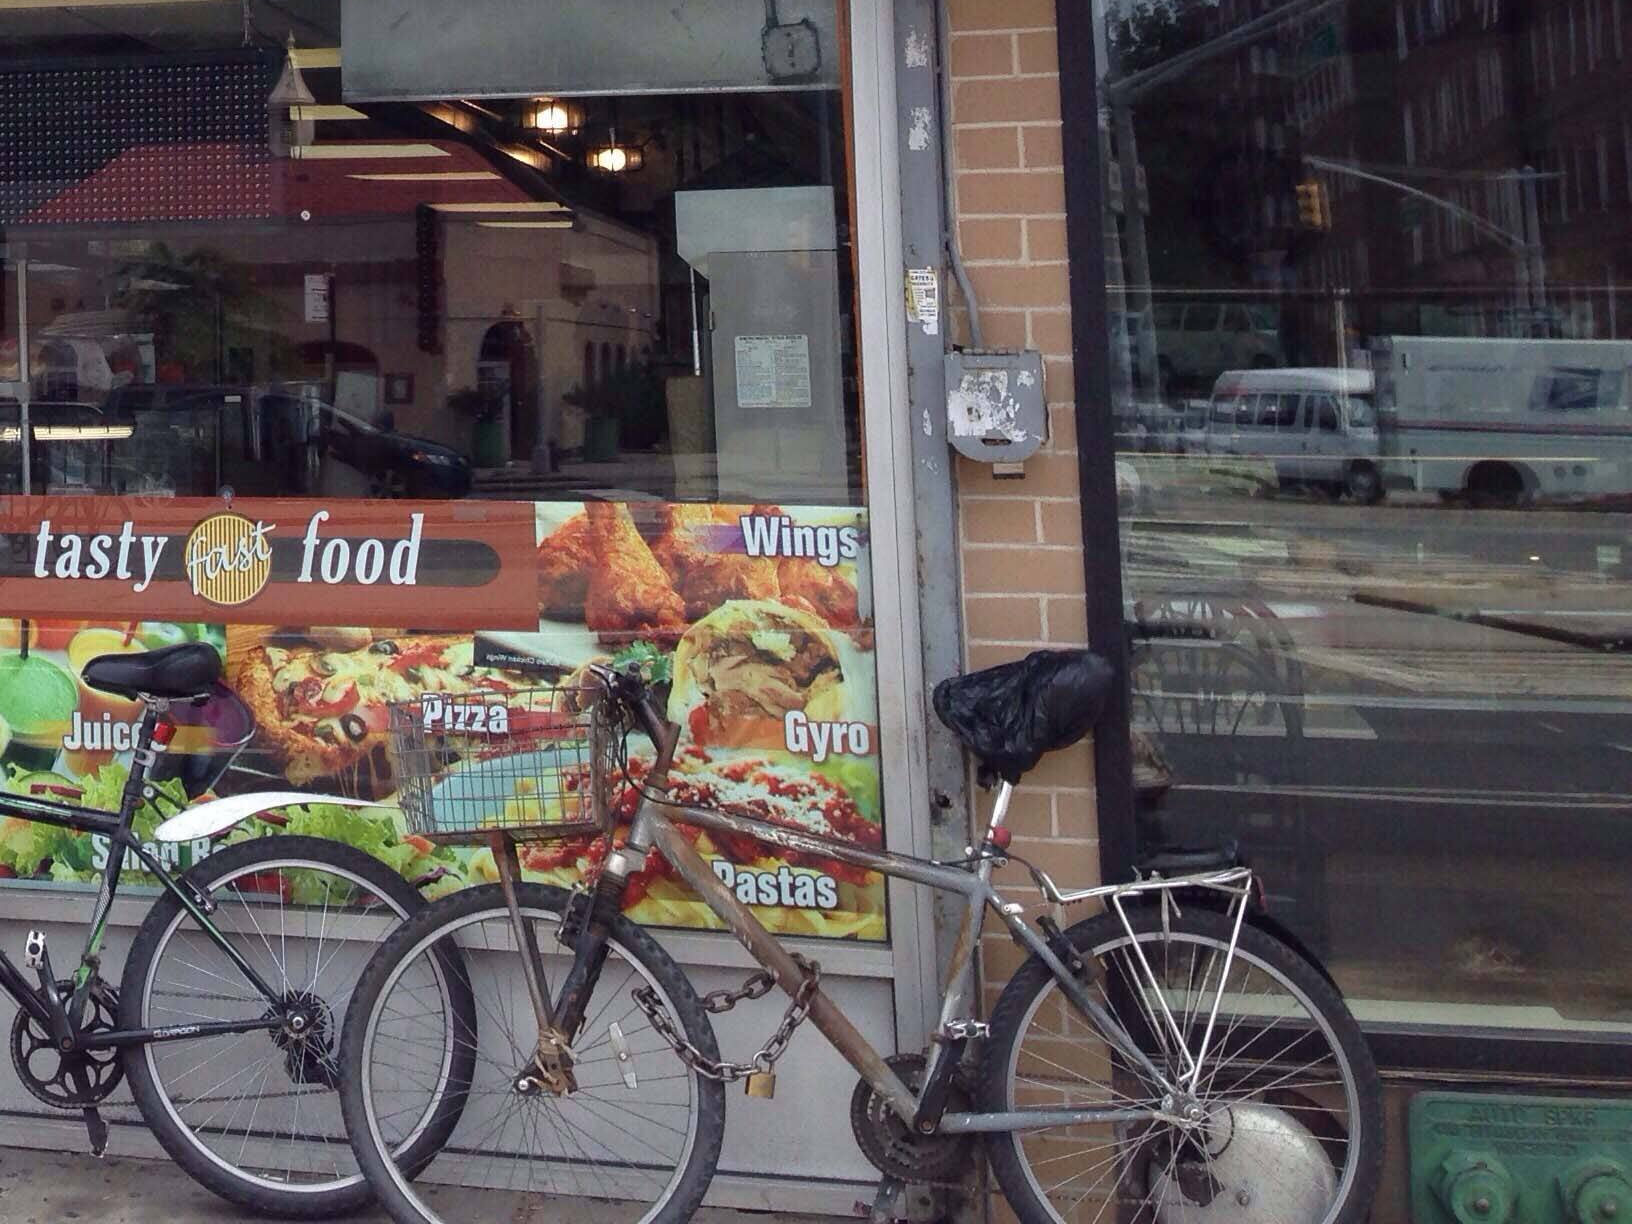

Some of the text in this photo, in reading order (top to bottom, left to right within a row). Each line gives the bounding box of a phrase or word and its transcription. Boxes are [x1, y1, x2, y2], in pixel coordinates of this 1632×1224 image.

[34, 510, 425, 596] tasty fast food
[740, 514, 860, 567] Wings
[422, 693, 509, 735] Pizza
[784, 710, 871, 763] Gyro
[713, 860, 838, 910] Pastas
